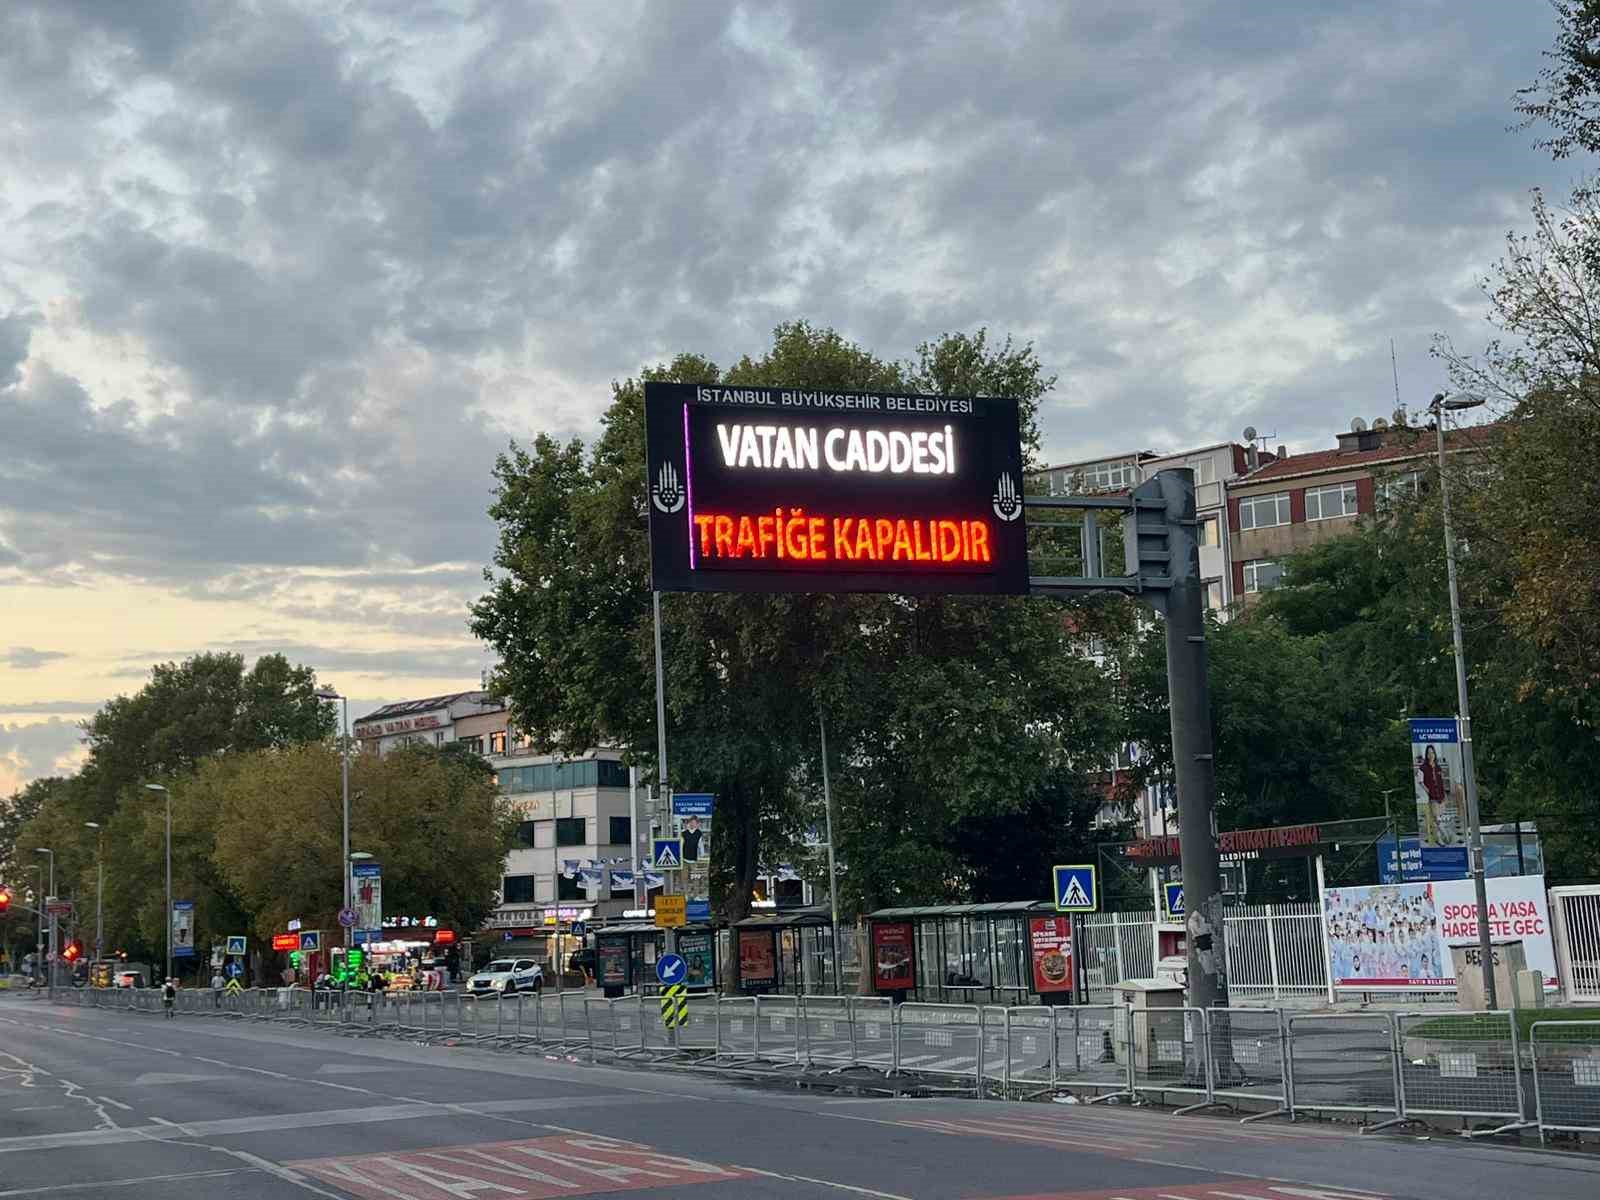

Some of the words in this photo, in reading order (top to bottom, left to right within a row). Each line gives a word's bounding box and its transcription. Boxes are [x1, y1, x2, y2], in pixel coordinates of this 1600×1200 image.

[697, 386, 775, 405] İSTANBUL
[781, 391, 881, 410] BÜYÜKŞEHİR
[886, 397, 973, 413] BELEDİYESİ
[716, 424, 821, 470] VATAN
[823, 425, 955, 474] CADDESİ
[694, 507, 828, 560] TRAFİĞE
[834, 517, 992, 562] KAPALIDIR
[1219, 850, 1260, 861] ELEDİYESİ
[1444, 903, 1498, 920] SPORA
[1441, 921, 1511, 938] HAREETE
